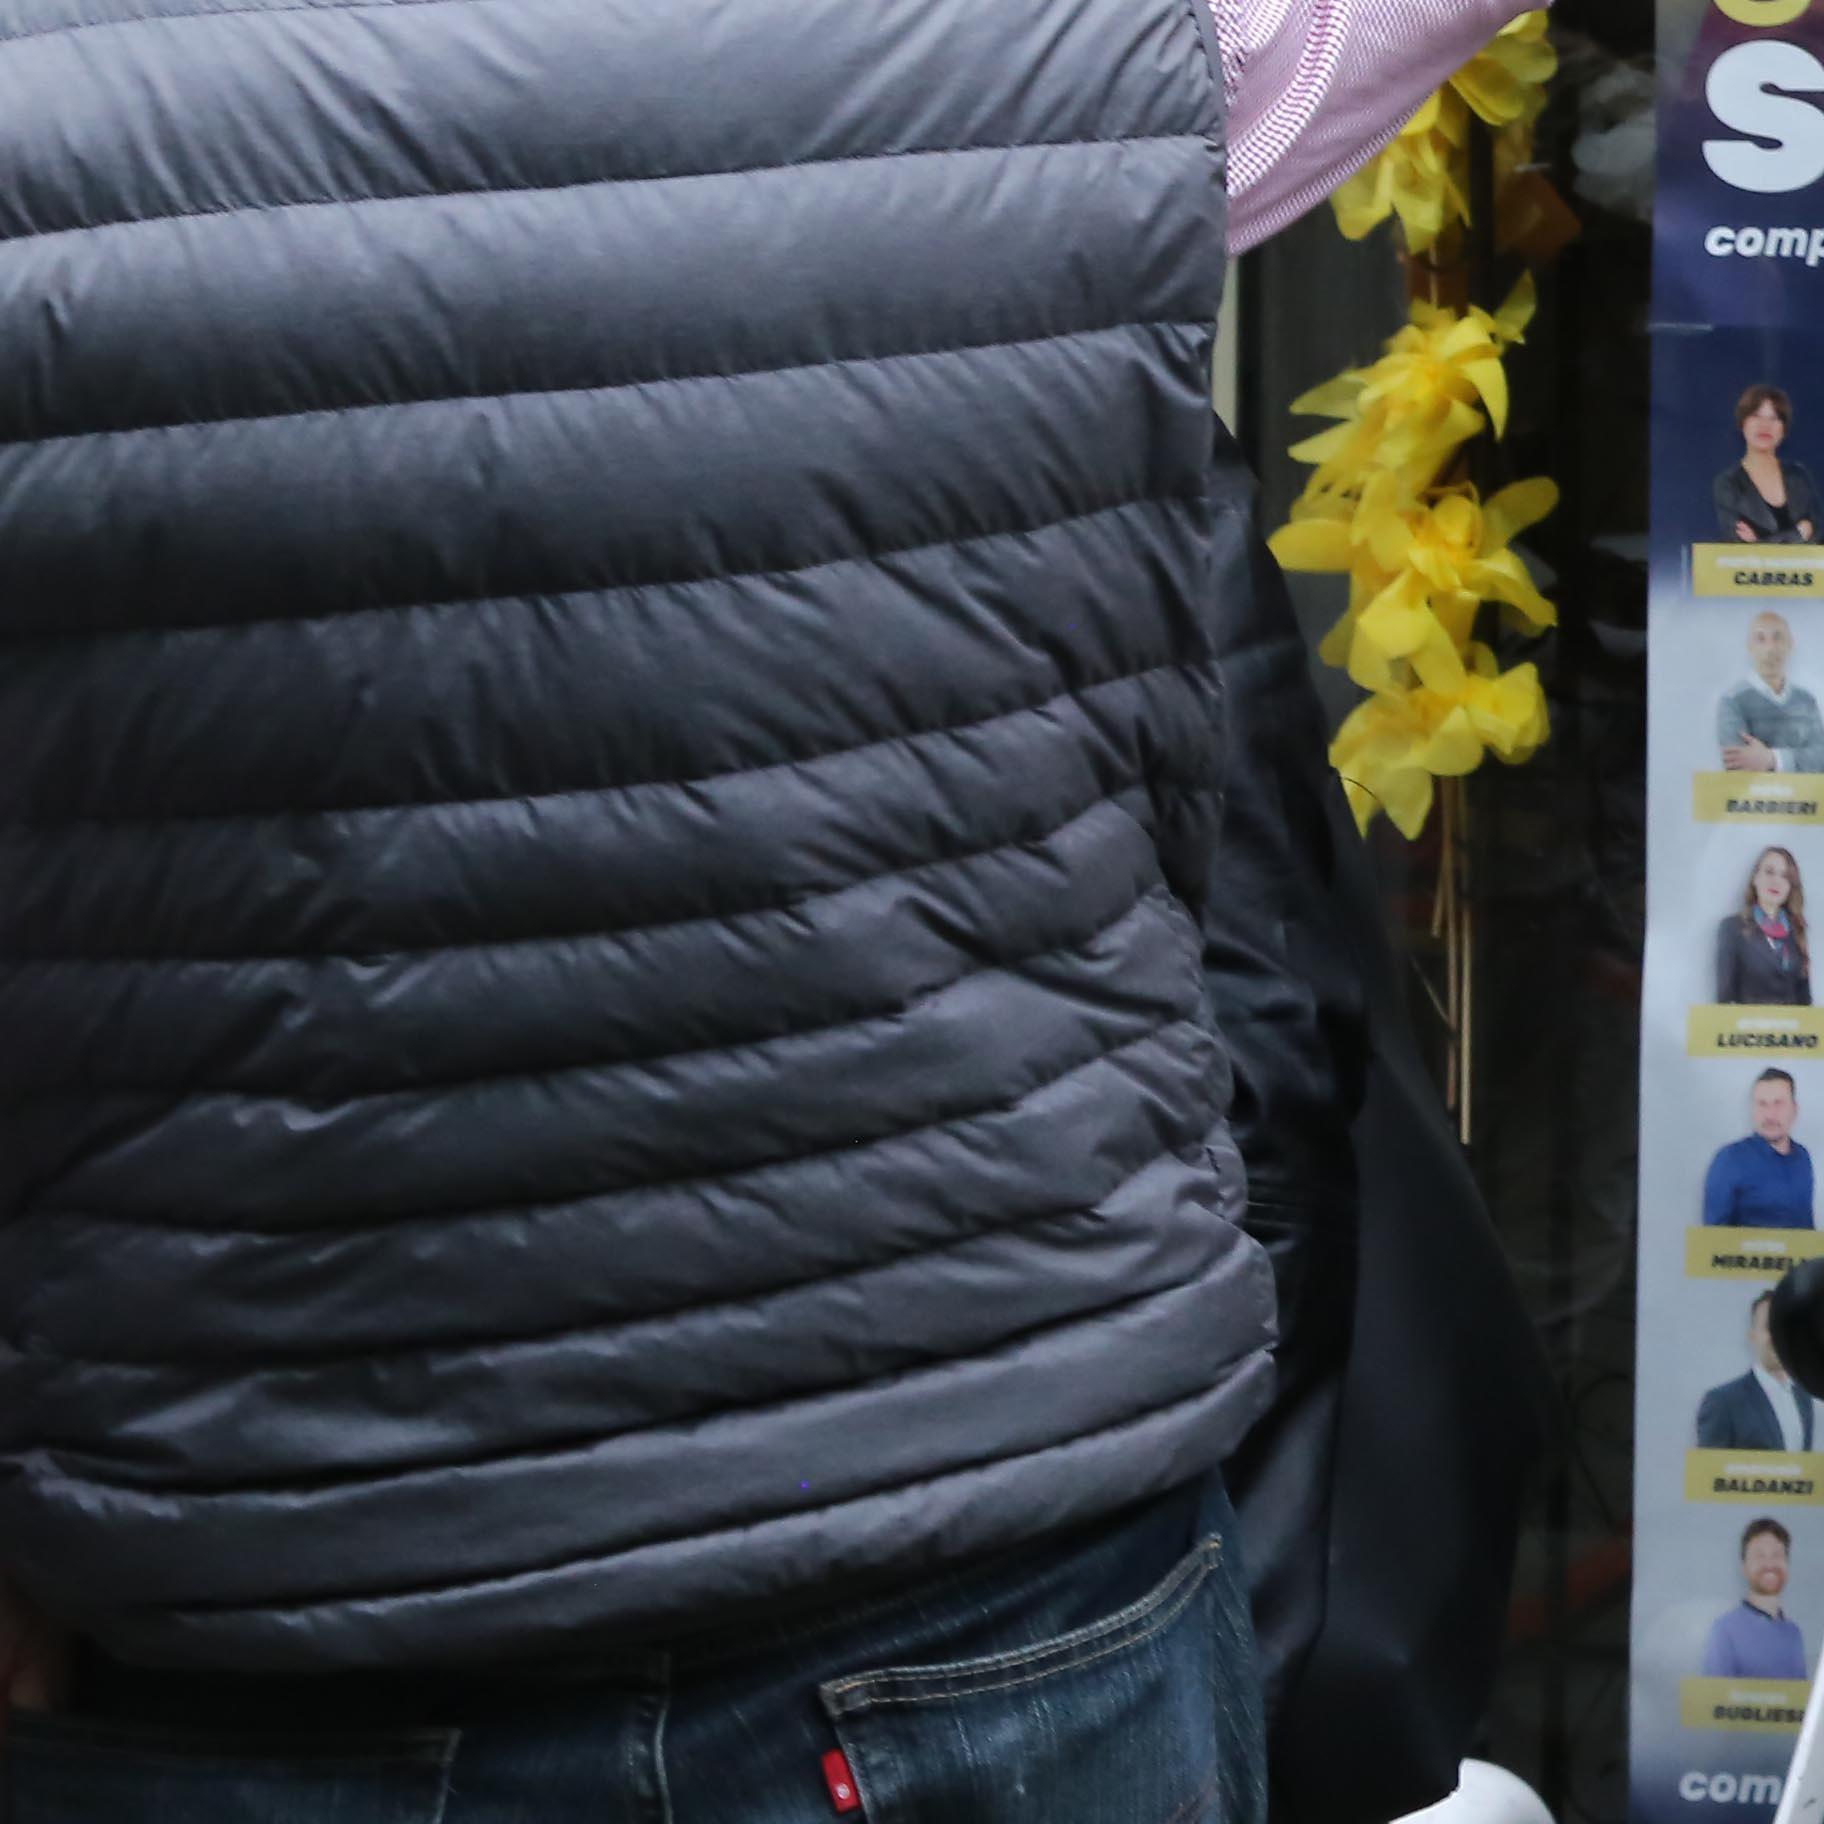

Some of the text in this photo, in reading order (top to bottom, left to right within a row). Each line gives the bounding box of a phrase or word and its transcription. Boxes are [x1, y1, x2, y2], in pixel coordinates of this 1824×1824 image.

[1734, 571, 1814, 587] CABRAS
[1717, 1033, 1819, 1049] LUCISANO
[1713, 1477, 1814, 1495] BALDANZI
